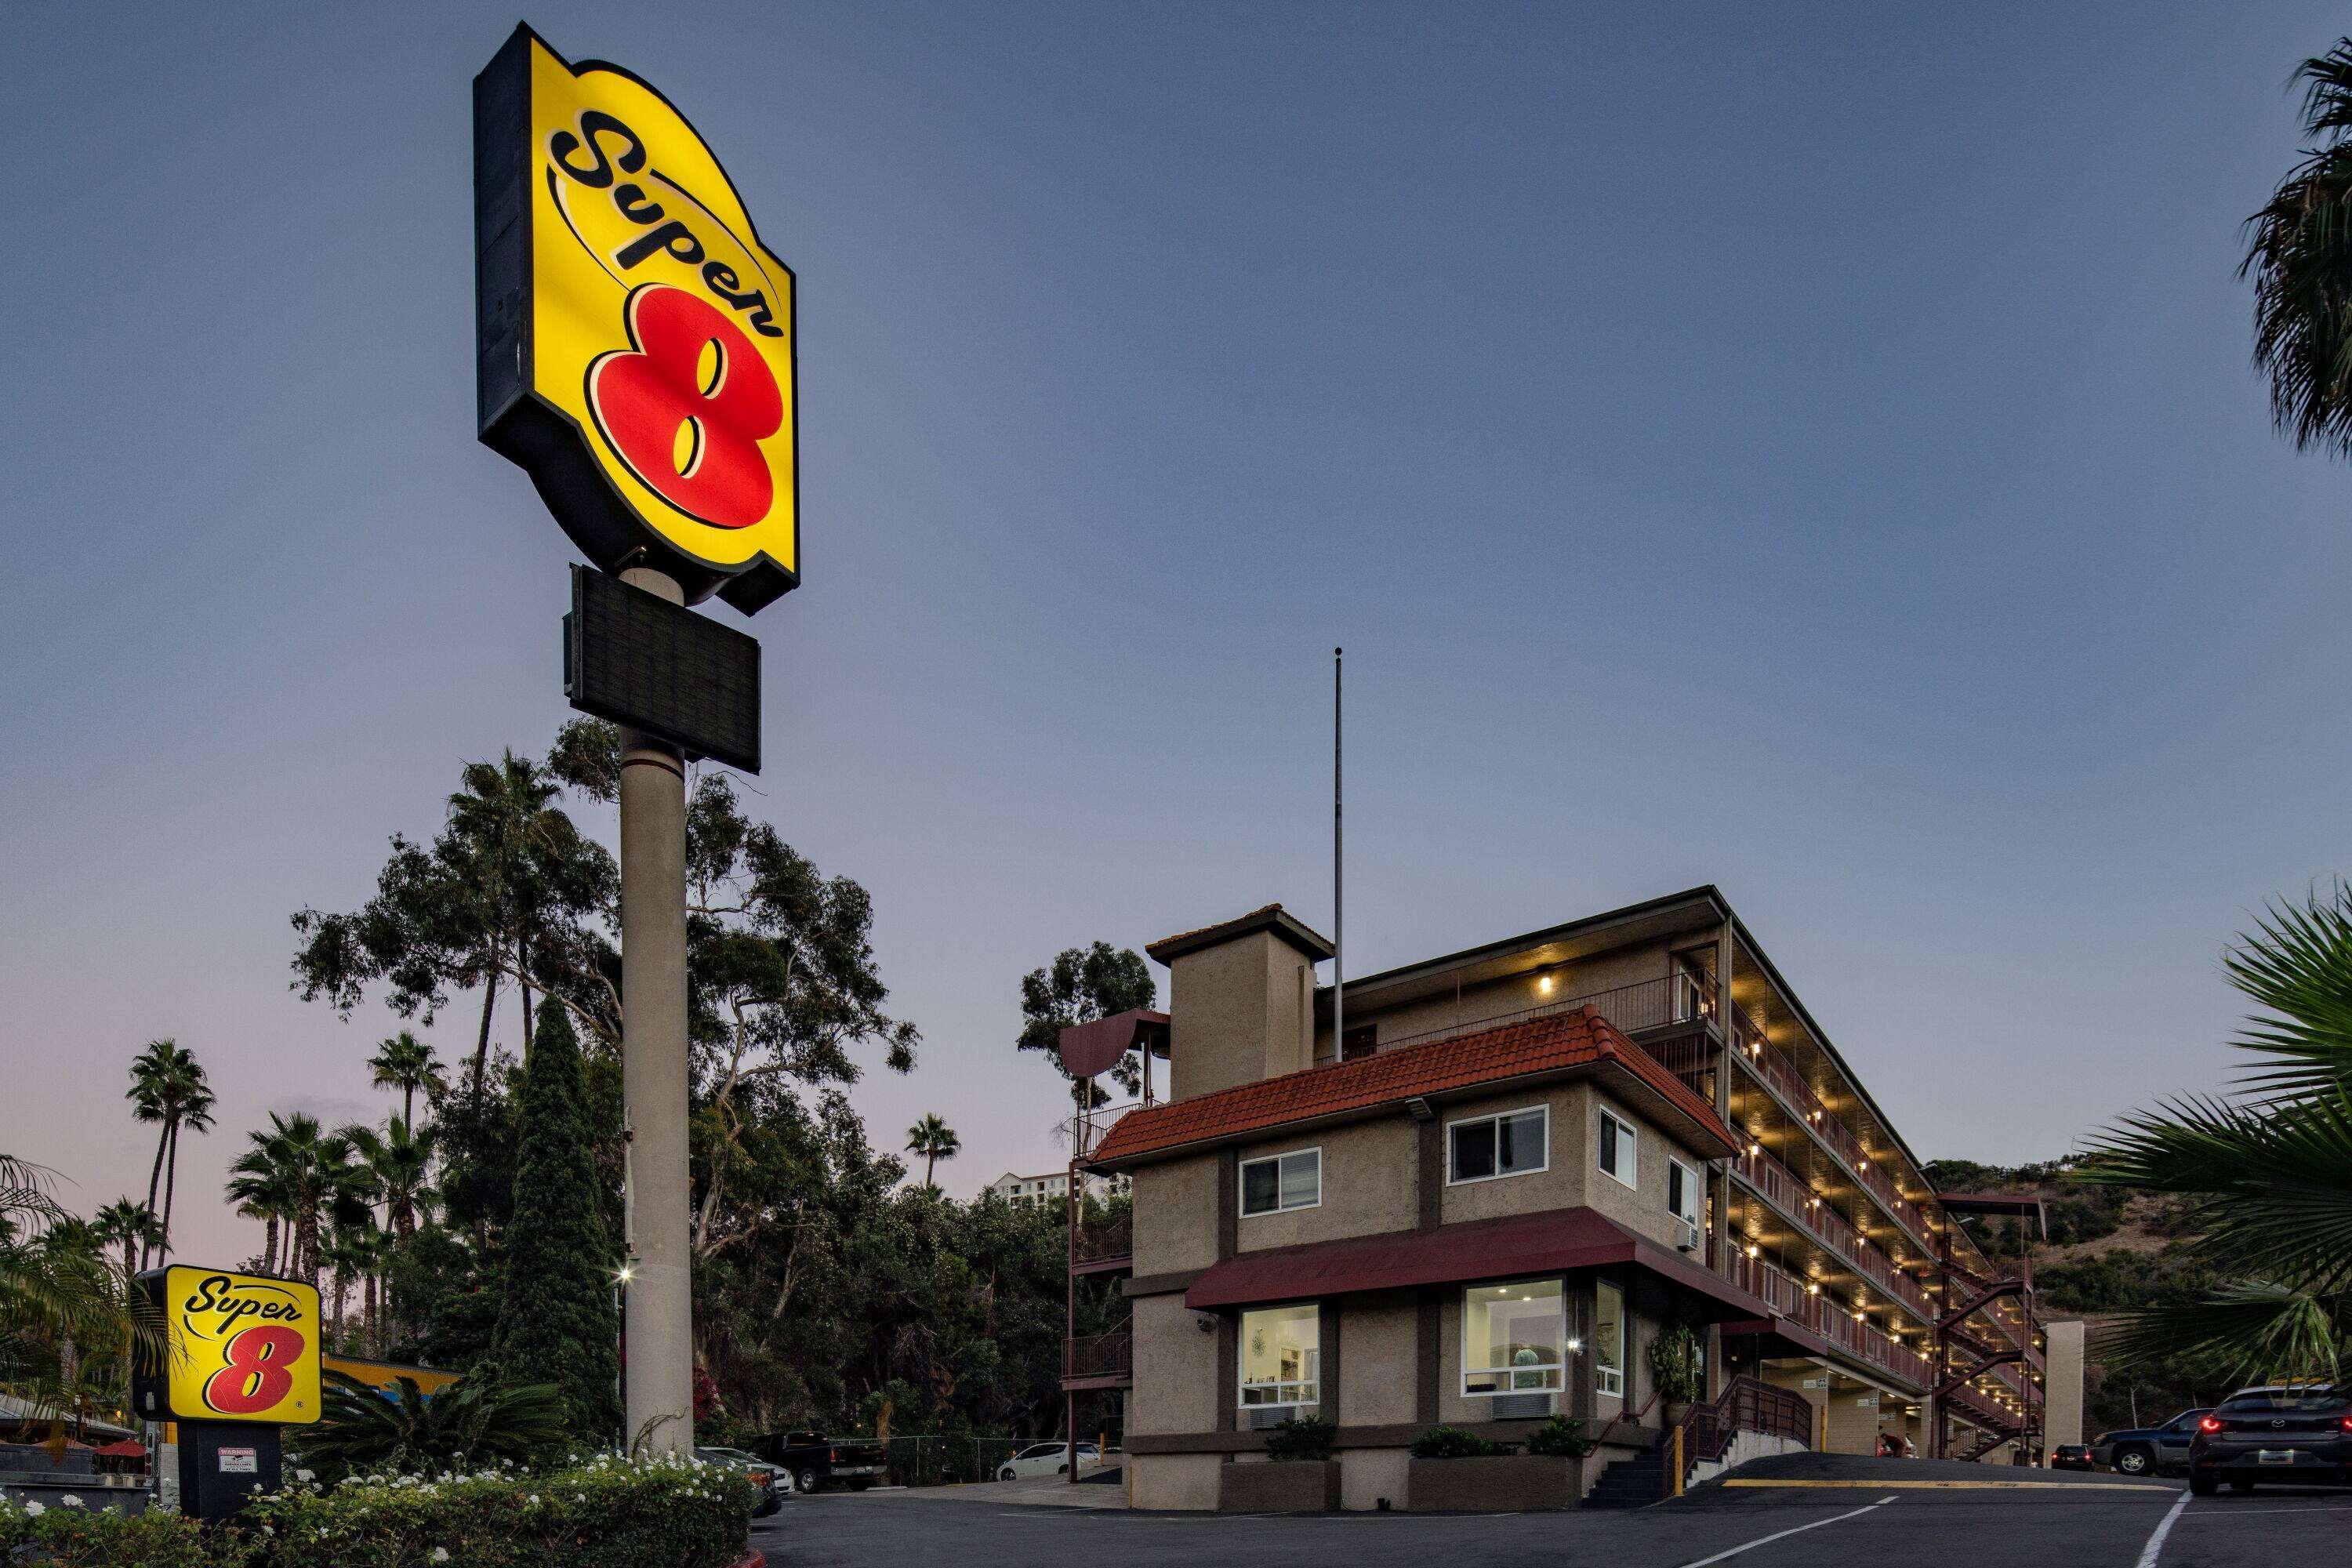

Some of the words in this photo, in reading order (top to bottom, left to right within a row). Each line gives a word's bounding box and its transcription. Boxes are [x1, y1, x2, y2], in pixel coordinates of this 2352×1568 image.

[548, 108, 784, 338] Super
[583, 283, 783, 529] 8
[184, 1276, 303, 1335] Super
[201, 1326, 305, 1414] 8
